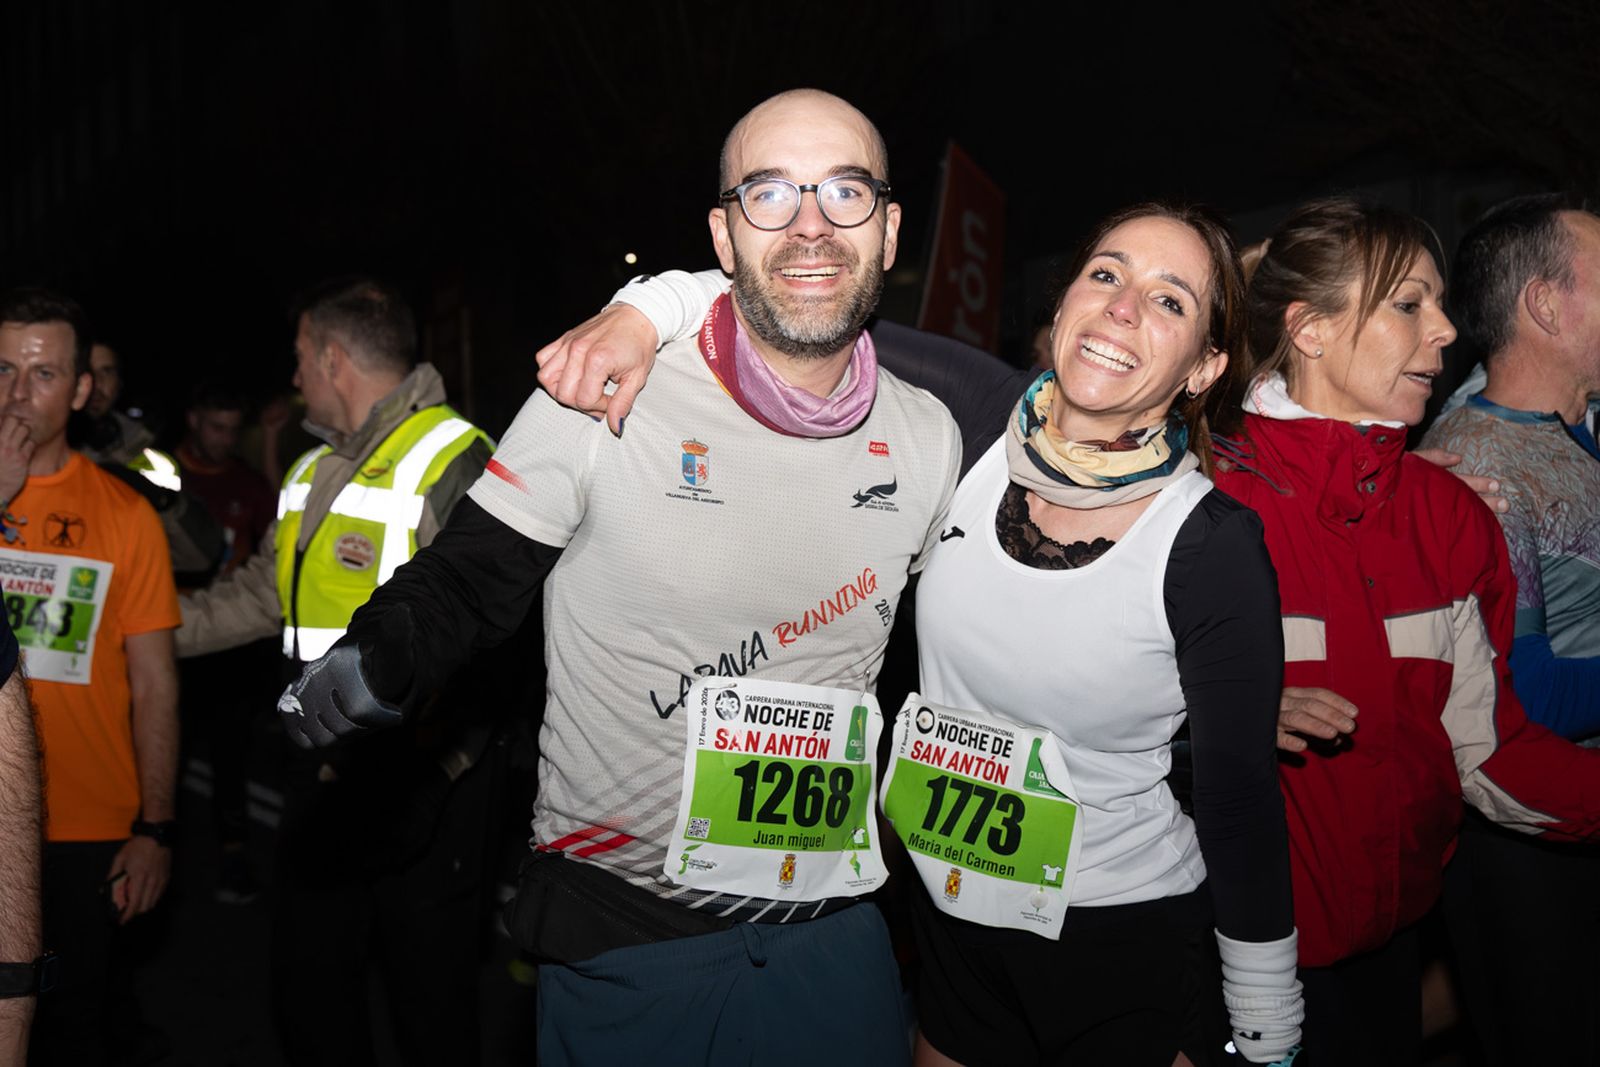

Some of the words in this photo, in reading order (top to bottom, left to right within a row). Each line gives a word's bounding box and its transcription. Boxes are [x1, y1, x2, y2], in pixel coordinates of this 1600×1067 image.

[705, 326, 718, 360] ANTON
[772, 567, 878, 648] RUNNING
[874, 598, 893, 627] 2025
[700, 707, 707, 716] de
[744, 694, 772, 704] CARRERA
[772, 697, 796, 707] URBANA
[796, 701, 835, 711] INTERNACIONAL
[743, 704, 811, 729] NOCHE
[812, 711, 834, 732] DE
[938, 713, 958, 723] CARRERA
[959, 719, 977, 729] URBANA
[977, 723, 1014, 738] INTERNACIONAL
[699, 737, 705, 746] 17
[763, 731, 830, 760] ANTÓN
[935, 721, 989, 752] NOCHE
[991, 736, 1014, 758] DE
[911, 740, 947, 767] SAN
[946, 755, 1009, 785] ANTÓN
[733, 759, 854, 829] 1268
[921, 775, 1026, 856] 1773
[753, 830, 784, 847] Juan
[787, 833, 826, 850] miguel
[944, 847, 962, 862] del
[966, 852, 1016, 877] Carmen
